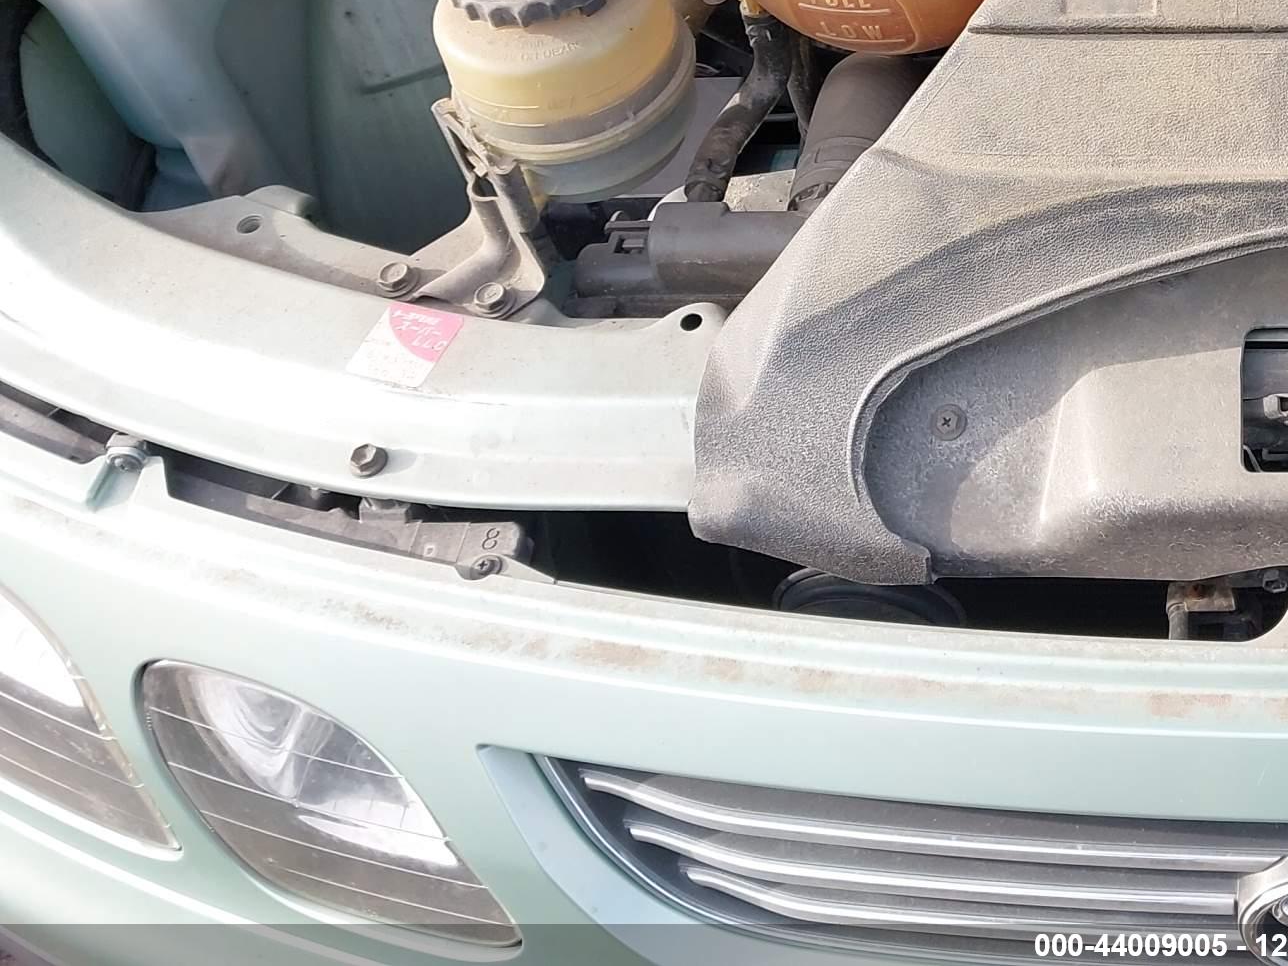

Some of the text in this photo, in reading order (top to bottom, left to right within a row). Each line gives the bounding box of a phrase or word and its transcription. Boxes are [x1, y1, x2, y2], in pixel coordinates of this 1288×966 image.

[818, 21, 884, 40] LOW
[410, 336, 448, 352] LLC
[481, 527, 501, 551] 8
